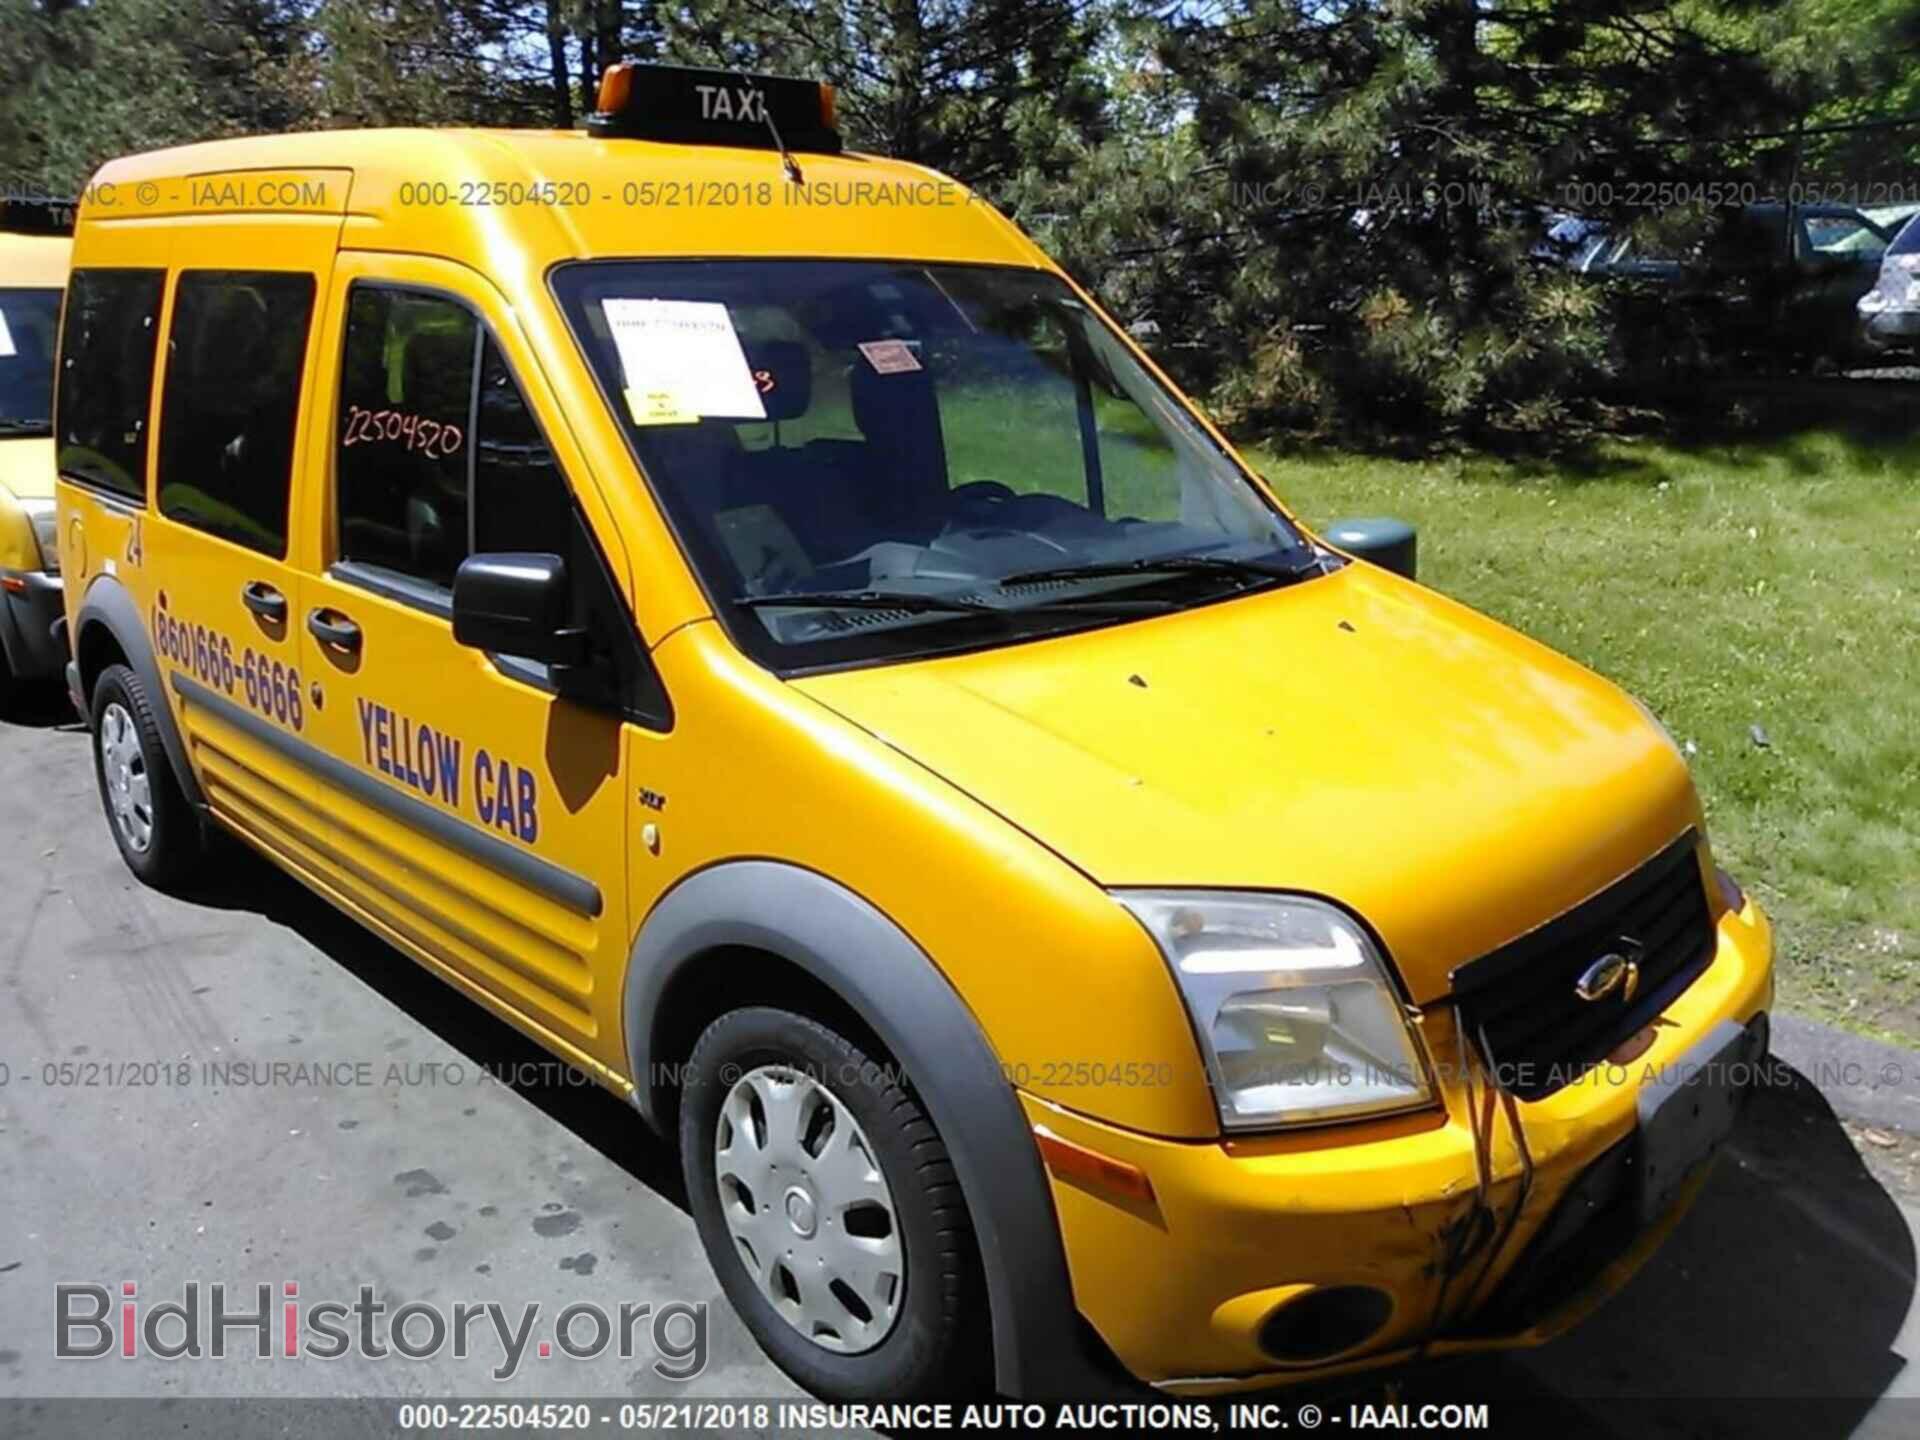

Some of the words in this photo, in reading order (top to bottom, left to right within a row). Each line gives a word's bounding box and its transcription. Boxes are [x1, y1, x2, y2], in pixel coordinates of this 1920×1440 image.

[695, 85, 765, 122] TAXI
[343, 405, 462, 459] 22504520
[152, 605, 304, 732] (860)666-6666
[357, 697, 461, 808] YELLOW
[474, 748, 538, 845] CAB
